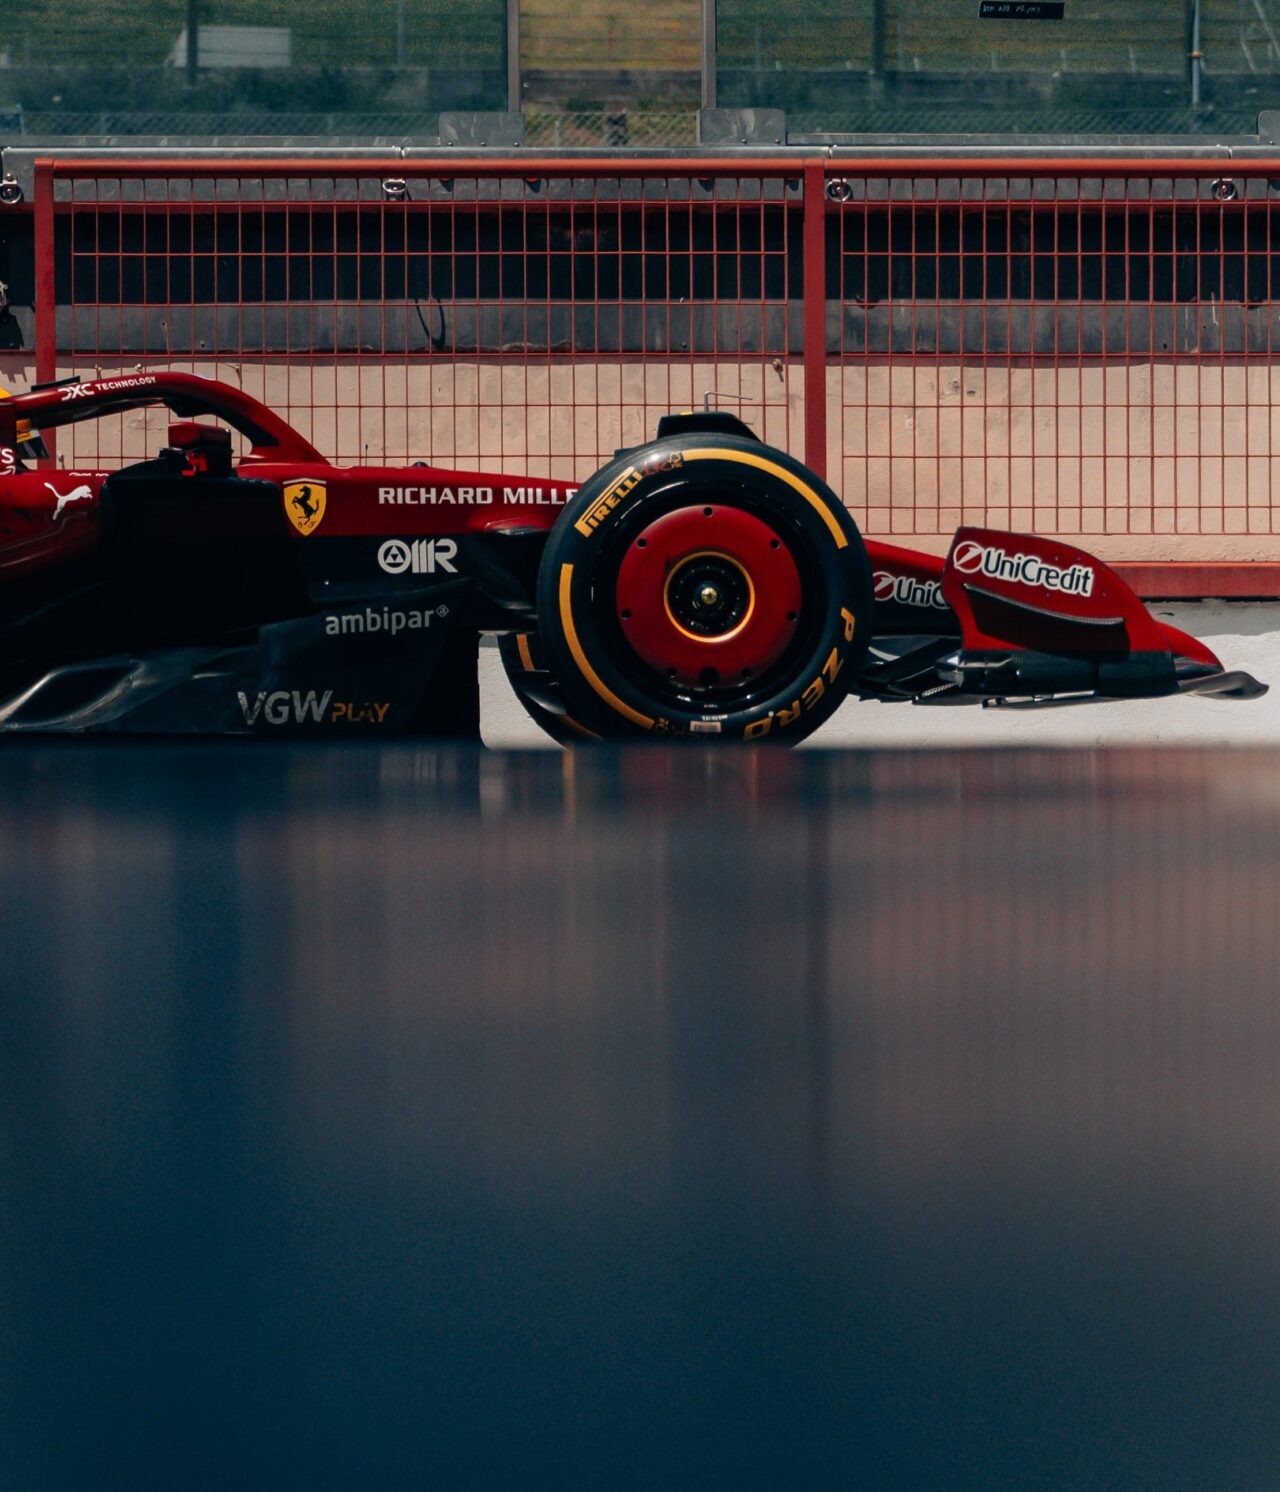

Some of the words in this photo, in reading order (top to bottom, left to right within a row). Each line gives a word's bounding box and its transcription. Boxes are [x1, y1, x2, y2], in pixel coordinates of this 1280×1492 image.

[96, 376, 157, 392] TECHNOLOGY
[378, 487, 493, 505] RICHARD
[574, 466, 643, 538] PIRELLI
[984, 548, 1093, 596] UniCredit
[325, 607, 434, 635] ambipar
[237, 690, 333, 726] VGW
[332, 702, 390, 723] PLAY
